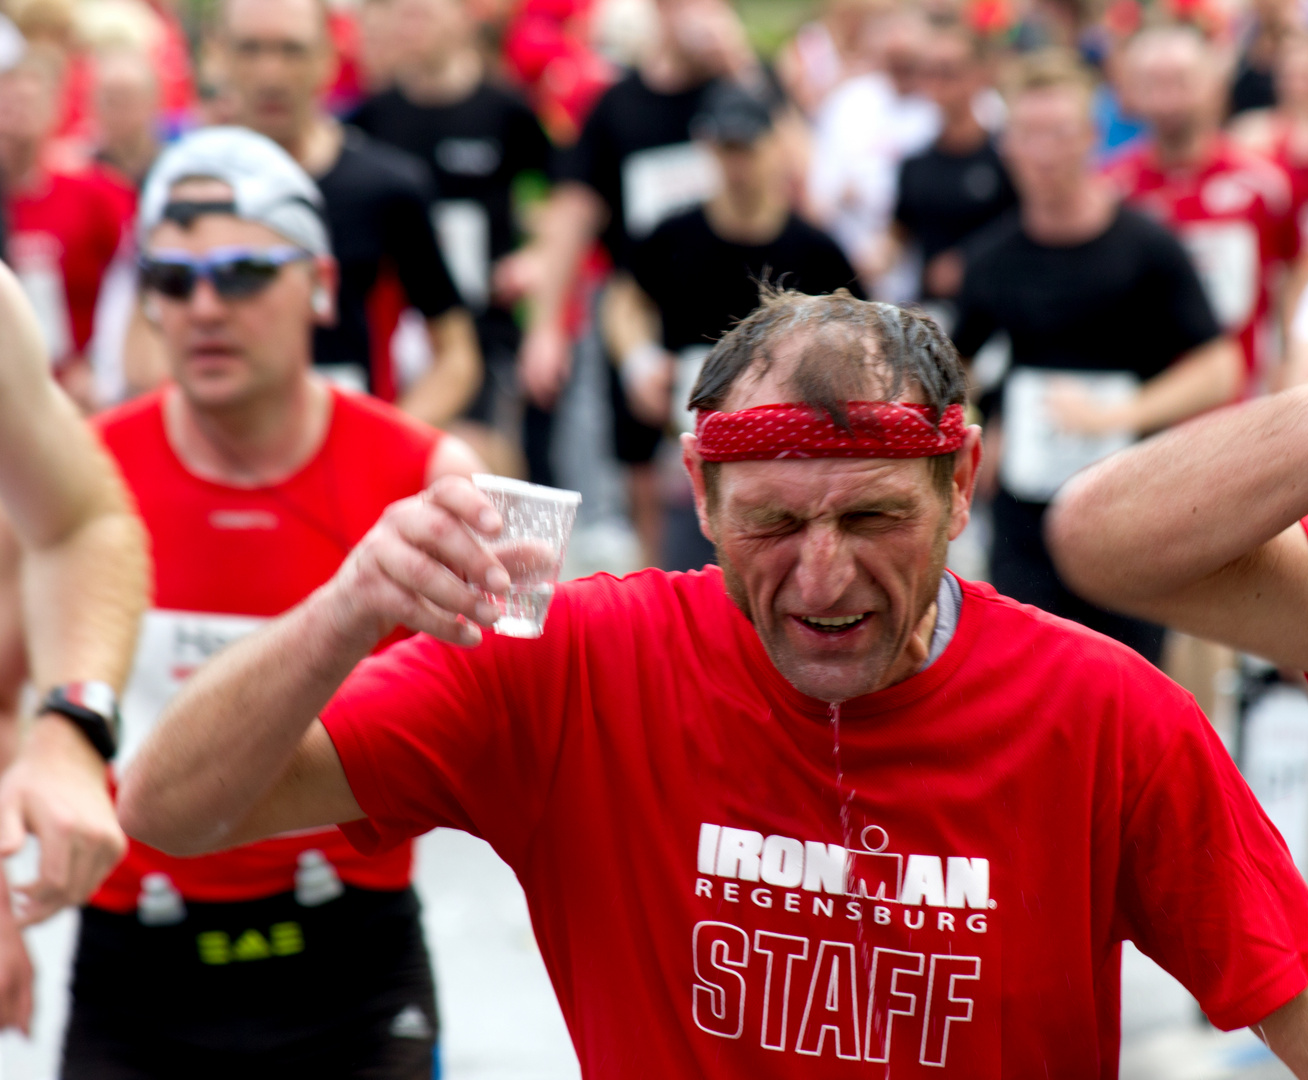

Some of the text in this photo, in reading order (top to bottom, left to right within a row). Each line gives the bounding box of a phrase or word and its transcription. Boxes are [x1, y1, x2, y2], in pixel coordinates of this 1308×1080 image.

[695, 877, 988, 933] REGENSBURG
[697, 822, 990, 910] IRONMAN
[692, 920, 982, 1068] STAFF
